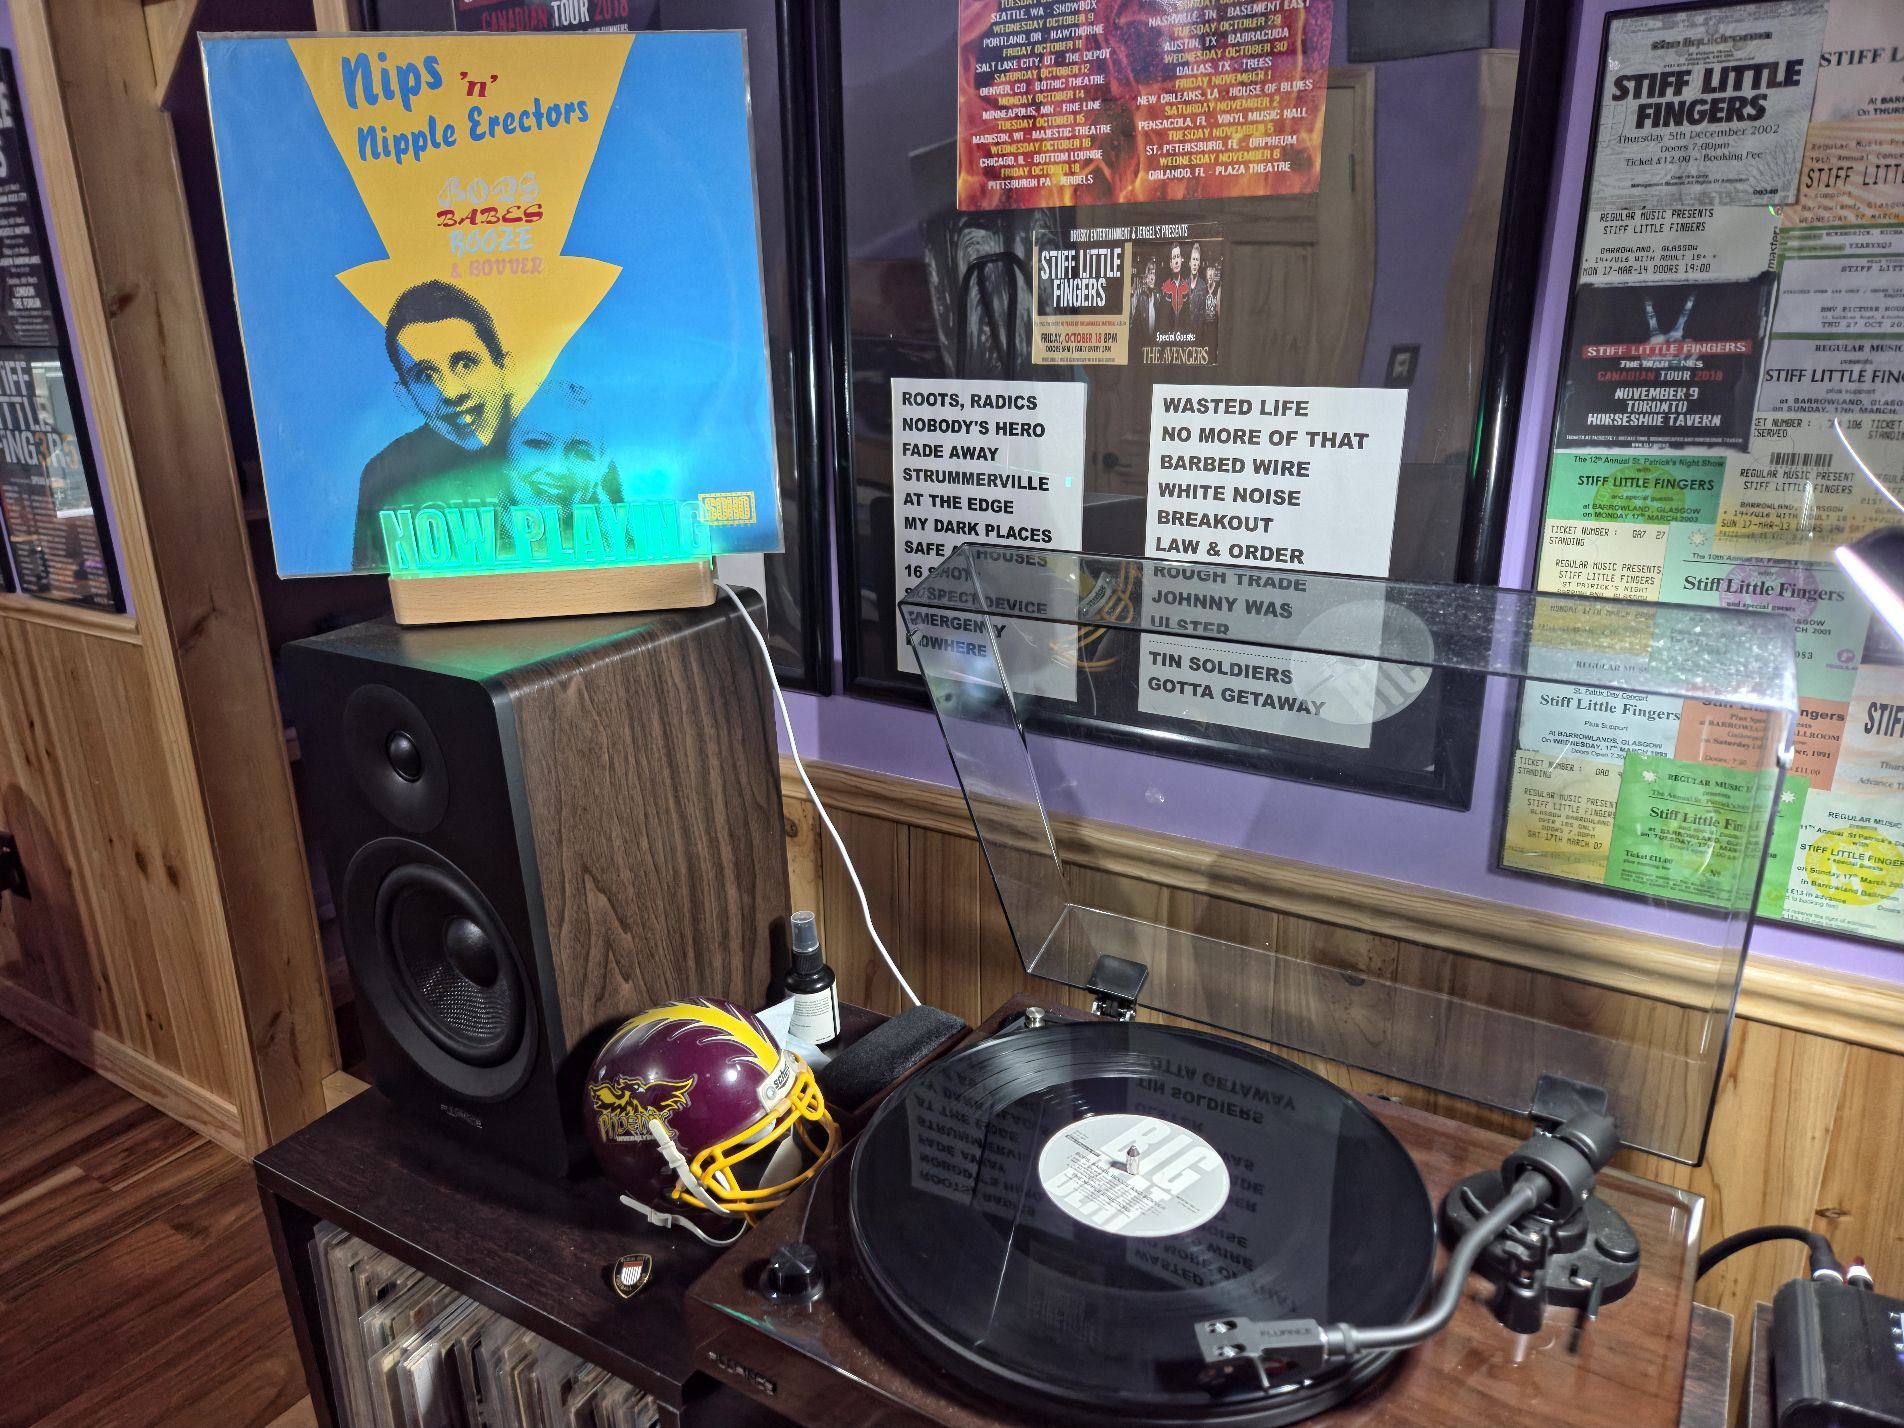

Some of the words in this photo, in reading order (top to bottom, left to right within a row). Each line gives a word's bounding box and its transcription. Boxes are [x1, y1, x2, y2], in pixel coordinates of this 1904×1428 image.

[482, 4, 549, 32] CANADIAN
[551, 0, 590, 27] TOUR
[594, 0, 629, 20] 2018
[991, 9, 1027, 22] SEATTLE,
[1031, 7, 1044, 16] WA
[1053, 1, 1097, 14] SHOWBOX
[976, 61, 995, 72] SALT
[998, 59, 1018, 70] LAKE
[1045, 55, 1055, 65] UT
[1065, 52, 1081, 62] THE
[1083, 48, 1112, 61] DEPOT
[1820, 48, 1885, 68] STIFF
[342, 51, 443, 112] Nips
[1612, 69, 1692, 102] STIFF
[1701, 59, 1804, 95] LITTLE
[1138, 96, 1157, 105] NEW
[1208, 89, 1219, 98] LA
[1229, 86, 1261, 97] HOUSE
[1265, 84, 1277, 93] OF
[1281, 79, 1313, 91] BLUES
[1635, 93, 1768, 129] FINGERS
[357, 115, 456, 165] Nipple
[468, 97, 589, 141] Erectors
[1617, 131, 1665, 145] Thursday
[1668, 131, 1686, 141] 5th
[1689, 128, 1746, 140] December
[1751, 124, 1780, 135] 2002
[1018, 153, 1025, 164] IL
[1034, 151, 1068, 164] BOTTOM
[1071, 150, 1103, 161] LOUNGE
[1626, 157, 1653, 167] Ticket
[1703, 152, 1743, 163] Booking
[1746, 151, 1763, 161] Fee
[1195, 168, 1205, 177] FL
[1216, 165, 1245, 176] PLAZA
[1249, 161, 1291, 172] THEATRE
[1806, 166, 1854, 189] STIFF
[436, 204, 544, 227] BABES
[1600, 212, 1636, 223] REGULAR
[1641, 210, 1666, 220] MUSIC
[1671, 209, 1714, 219] PRESENTS
[1091, 227, 1130, 241] ENTERTAINMENT
[1132, 227, 1135, 239] &
[1161, 224, 1188, 238] PRESENTS
[1603, 225, 1629, 235] STIFF
[1634, 223, 1664, 234] LITTLE
[1670, 222, 1706, 232] FINGERS
[448, 226, 535, 259] BOOZE
[1041, 249, 1075, 280] STIFF
[1079, 248, 1121, 278] LITTLE
[1583, 267, 1599, 276] MON
[1653, 265, 1679, 274] DOORS
[1684, 264, 1711, 273] 19:00
[1053, 278, 1106, 307] FINGERS
[1041, 333, 1063, 344] FRIDAY,
[1065, 333, 1092, 344] OCTOBER
[1103, 333, 1117, 343] 8PM
[1156, 332, 1174, 343] Special
[1142, 347, 1161, 364] THE
[1162, 347, 1208, 365] AVENGERS
[1588, 346, 1627, 357] STIFF
[1632, 344, 1678, 355] LITTLE
[1684, 343, 1746, 353] FINGERS
[1660, 371, 1690, 381] TOUR
[1766, 369, 1807, 382] STIFF
[1811, 369, 1866, 383] LITTLE
[902, 392, 965, 410] ROOTS,
[970, 393, 1037, 411] RADICS
[1615, 388, 1686, 400] NOVEMBER
[1690, 388, 1699, 399] 9
[1163, 397, 1252, 416] WASTED
[1260, 399, 1310, 418] LIFE
[1627, 401, 1687, 412] TORONTO
[902, 417, 989, 435] NOBODY'S
[995, 422, 1045, 437] HERO
[1588, 414, 1664, 426] HORSESHOE
[1668, 415, 1721, 426] TAVERN
[1161, 426, 1192, 443] NO
[1199, 427, 1261, 446] MORE
[1269, 430, 1299, 447] OF
[1306, 431, 1369, 450] THAT
[902, 443, 943, 459] FADE
[949, 445, 999, 462] AWAY
[1160, 454, 1246, 474] BARBED
[1252, 458, 1311, 478] WIRE
[903, 468, 1050, 492] STRUMMERVILLE
[1578, 476, 1609, 487] STIFF
[1613, 477, 1649, 488] LITTLE
[1654, 479, 1715, 491] FINGERS
[903, 493, 926, 506] AT
[929, 494, 962, 510] THE
[968, 497, 1014, 514] EDGE
[1158, 482, 1225, 501] WHITE
[1233, 486, 1301, 507] NOISE
[705, 496, 750, 520] SOHO
[905, 517, 928, 532] MY
[934, 519, 979, 537] DARK
[985, 523, 1052, 543] PLACES
[1157, 510, 1274, 533] BREAKOUT
[1551, 526, 1577, 535] TICKET
[1582, 527, 1609, 536] NUMBER
[379, 507, 496, 570] NOW
[511, 500, 710, 563] PLAYING
[1549, 537, 1585, 547] STANDING
[905, 541, 944, 557] SAFE
[976, 549, 1048, 567] HOUSES
[1155, 536, 1200, 555] LAW
[1207, 541, 1221, 558] &
[1228, 542, 1305, 564] ORDER
[905, 564, 922, 578] 16
[1555, 560, 1589, 570] REGULAR
[1592, 562, 1617, 572] MUSIC
[1621, 564, 1662, 574] PRESENTS
[1154, 566, 1226, 584] ROUGH
[1234, 573, 1307, 592] TRADE
[1559, 571, 1583, 580] STIFF
[1586, 573, 1615, 583] LITTLE
[1620, 575, 1655, 585] FINGERS
[1683, 576, 1724, 592] Stiff
[1725, 578, 1774, 596] Little
[1778, 583, 1845, 602] Fingers
[986, 598, 1048, 614] DEVICE
[1152, 589, 1238, 612] JOHNNY
[1245, 599, 1293, 619] WAS
[1151, 615, 1229, 635] ULSTER
[1149, 651, 1183, 669] TIN
[1188, 656, 1294, 685] SOLDIERS
[1147, 677, 1214, 699] GOTTA
[1221, 686, 1327, 716] GETAWAY
[1540, 694, 1574, 709] Stiff
[1576, 699, 1617, 713] Little
[1621, 703, 1681, 722] Fingers
[1649, 806, 1678, 820] Stiff
[1682, 812, 1720, 828] Little
[1800, 843, 1828, 853] STIFF
[1831, 849, 1865, 860] LITTLE
